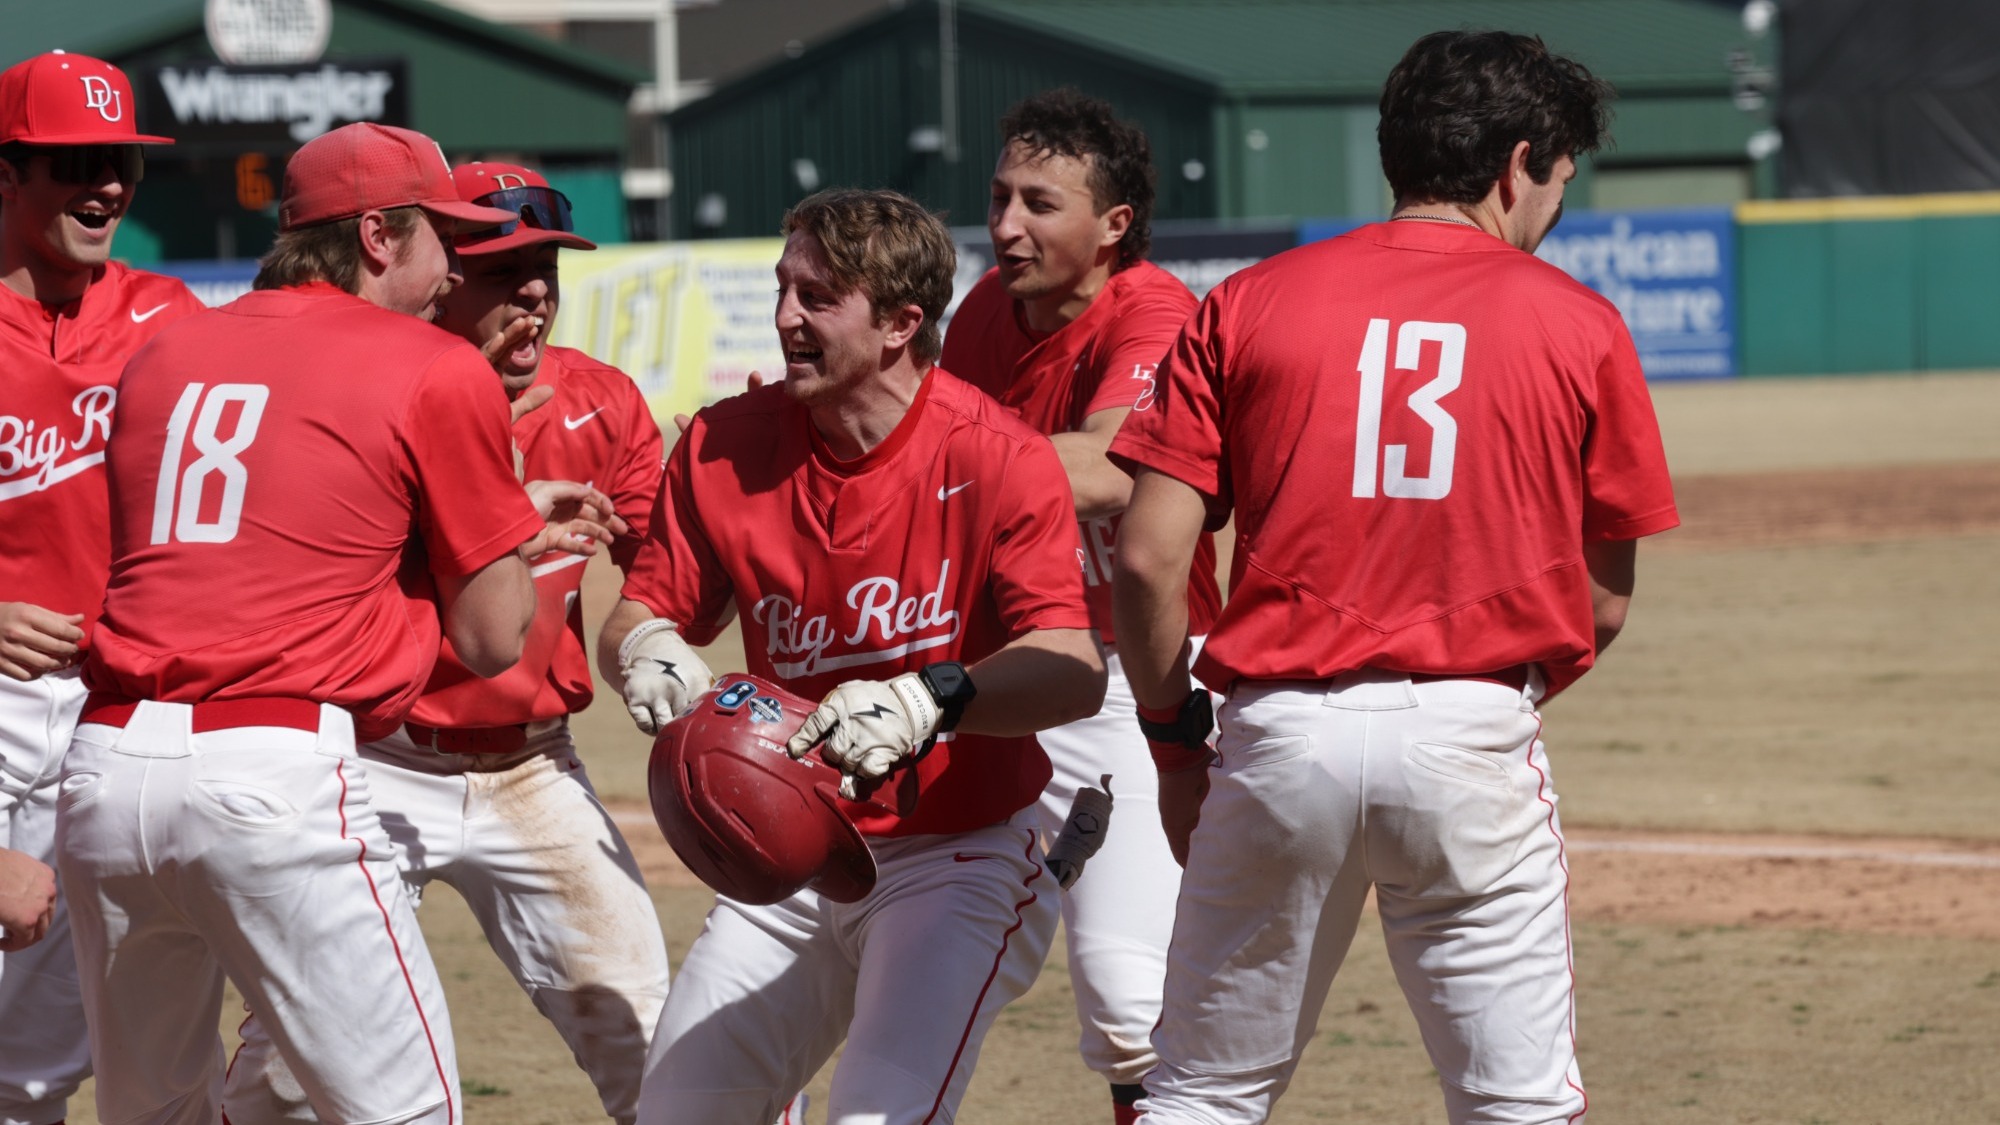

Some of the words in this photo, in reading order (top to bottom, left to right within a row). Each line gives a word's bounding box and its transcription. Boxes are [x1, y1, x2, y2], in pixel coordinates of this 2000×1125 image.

[80, 76, 122, 122] DU
[157, 65, 392, 141] Wrangler
[235, 152, 275, 210] 6
[1352, 318, 1467, 500] 13
[0, 415, 65, 491] Big
[150, 382, 270, 545] 18
[752, 594, 835, 676] Big
[844, 558, 958, 645] Red
